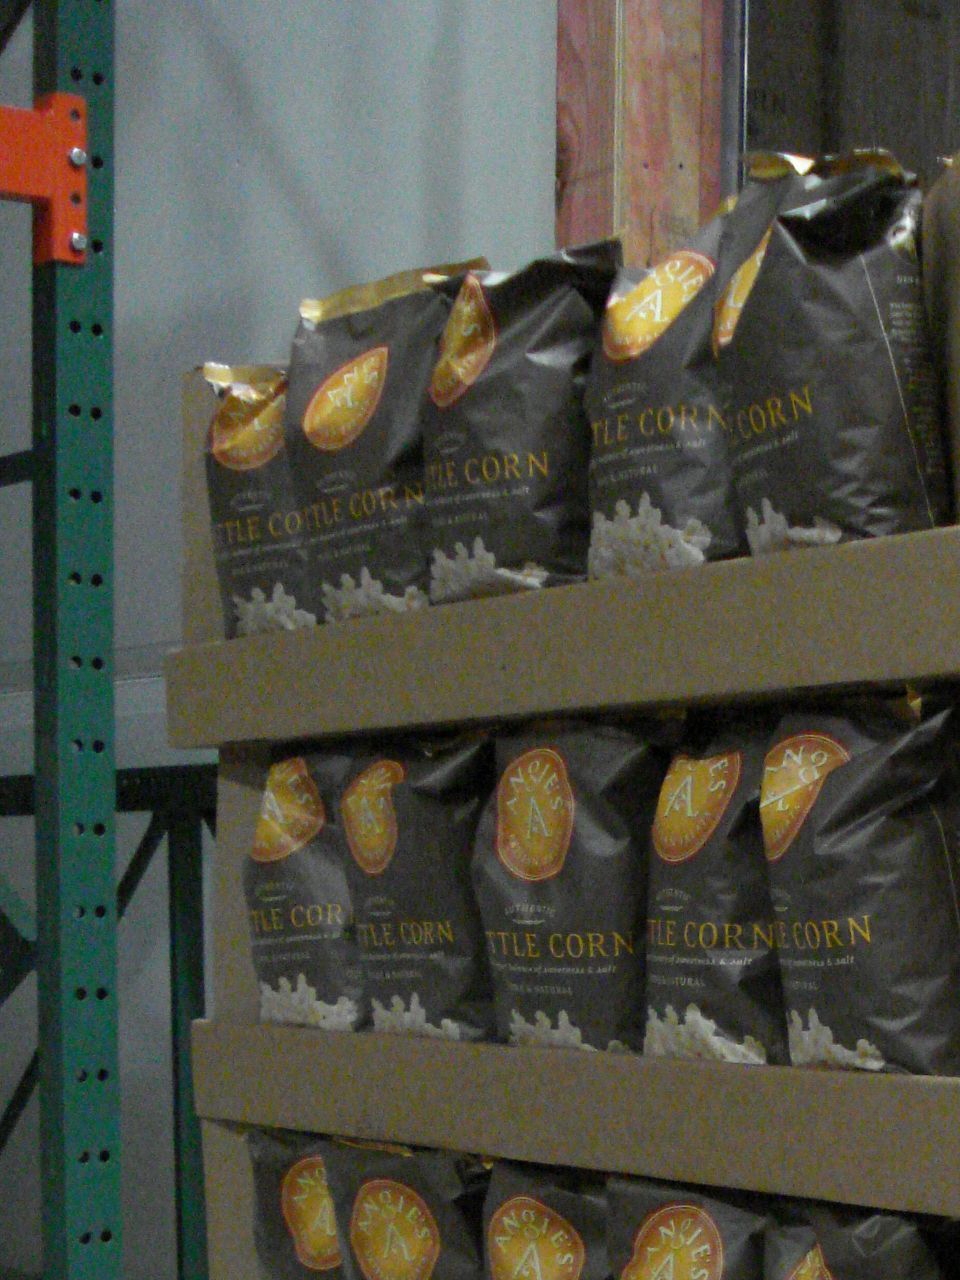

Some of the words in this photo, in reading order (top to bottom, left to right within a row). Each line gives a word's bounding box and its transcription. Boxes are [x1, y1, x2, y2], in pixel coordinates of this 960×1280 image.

[639, 404, 726, 436] CORN
[738, 385, 814, 439] CORN
[464, 451, 549, 484] CORN
[350, 482, 425, 519] CORN
[400, 919, 454, 945] CORN
[549, 931, 634, 959] CORN
[683, 920, 774, 951] CORN
[793, 915, 872, 950] CORN
